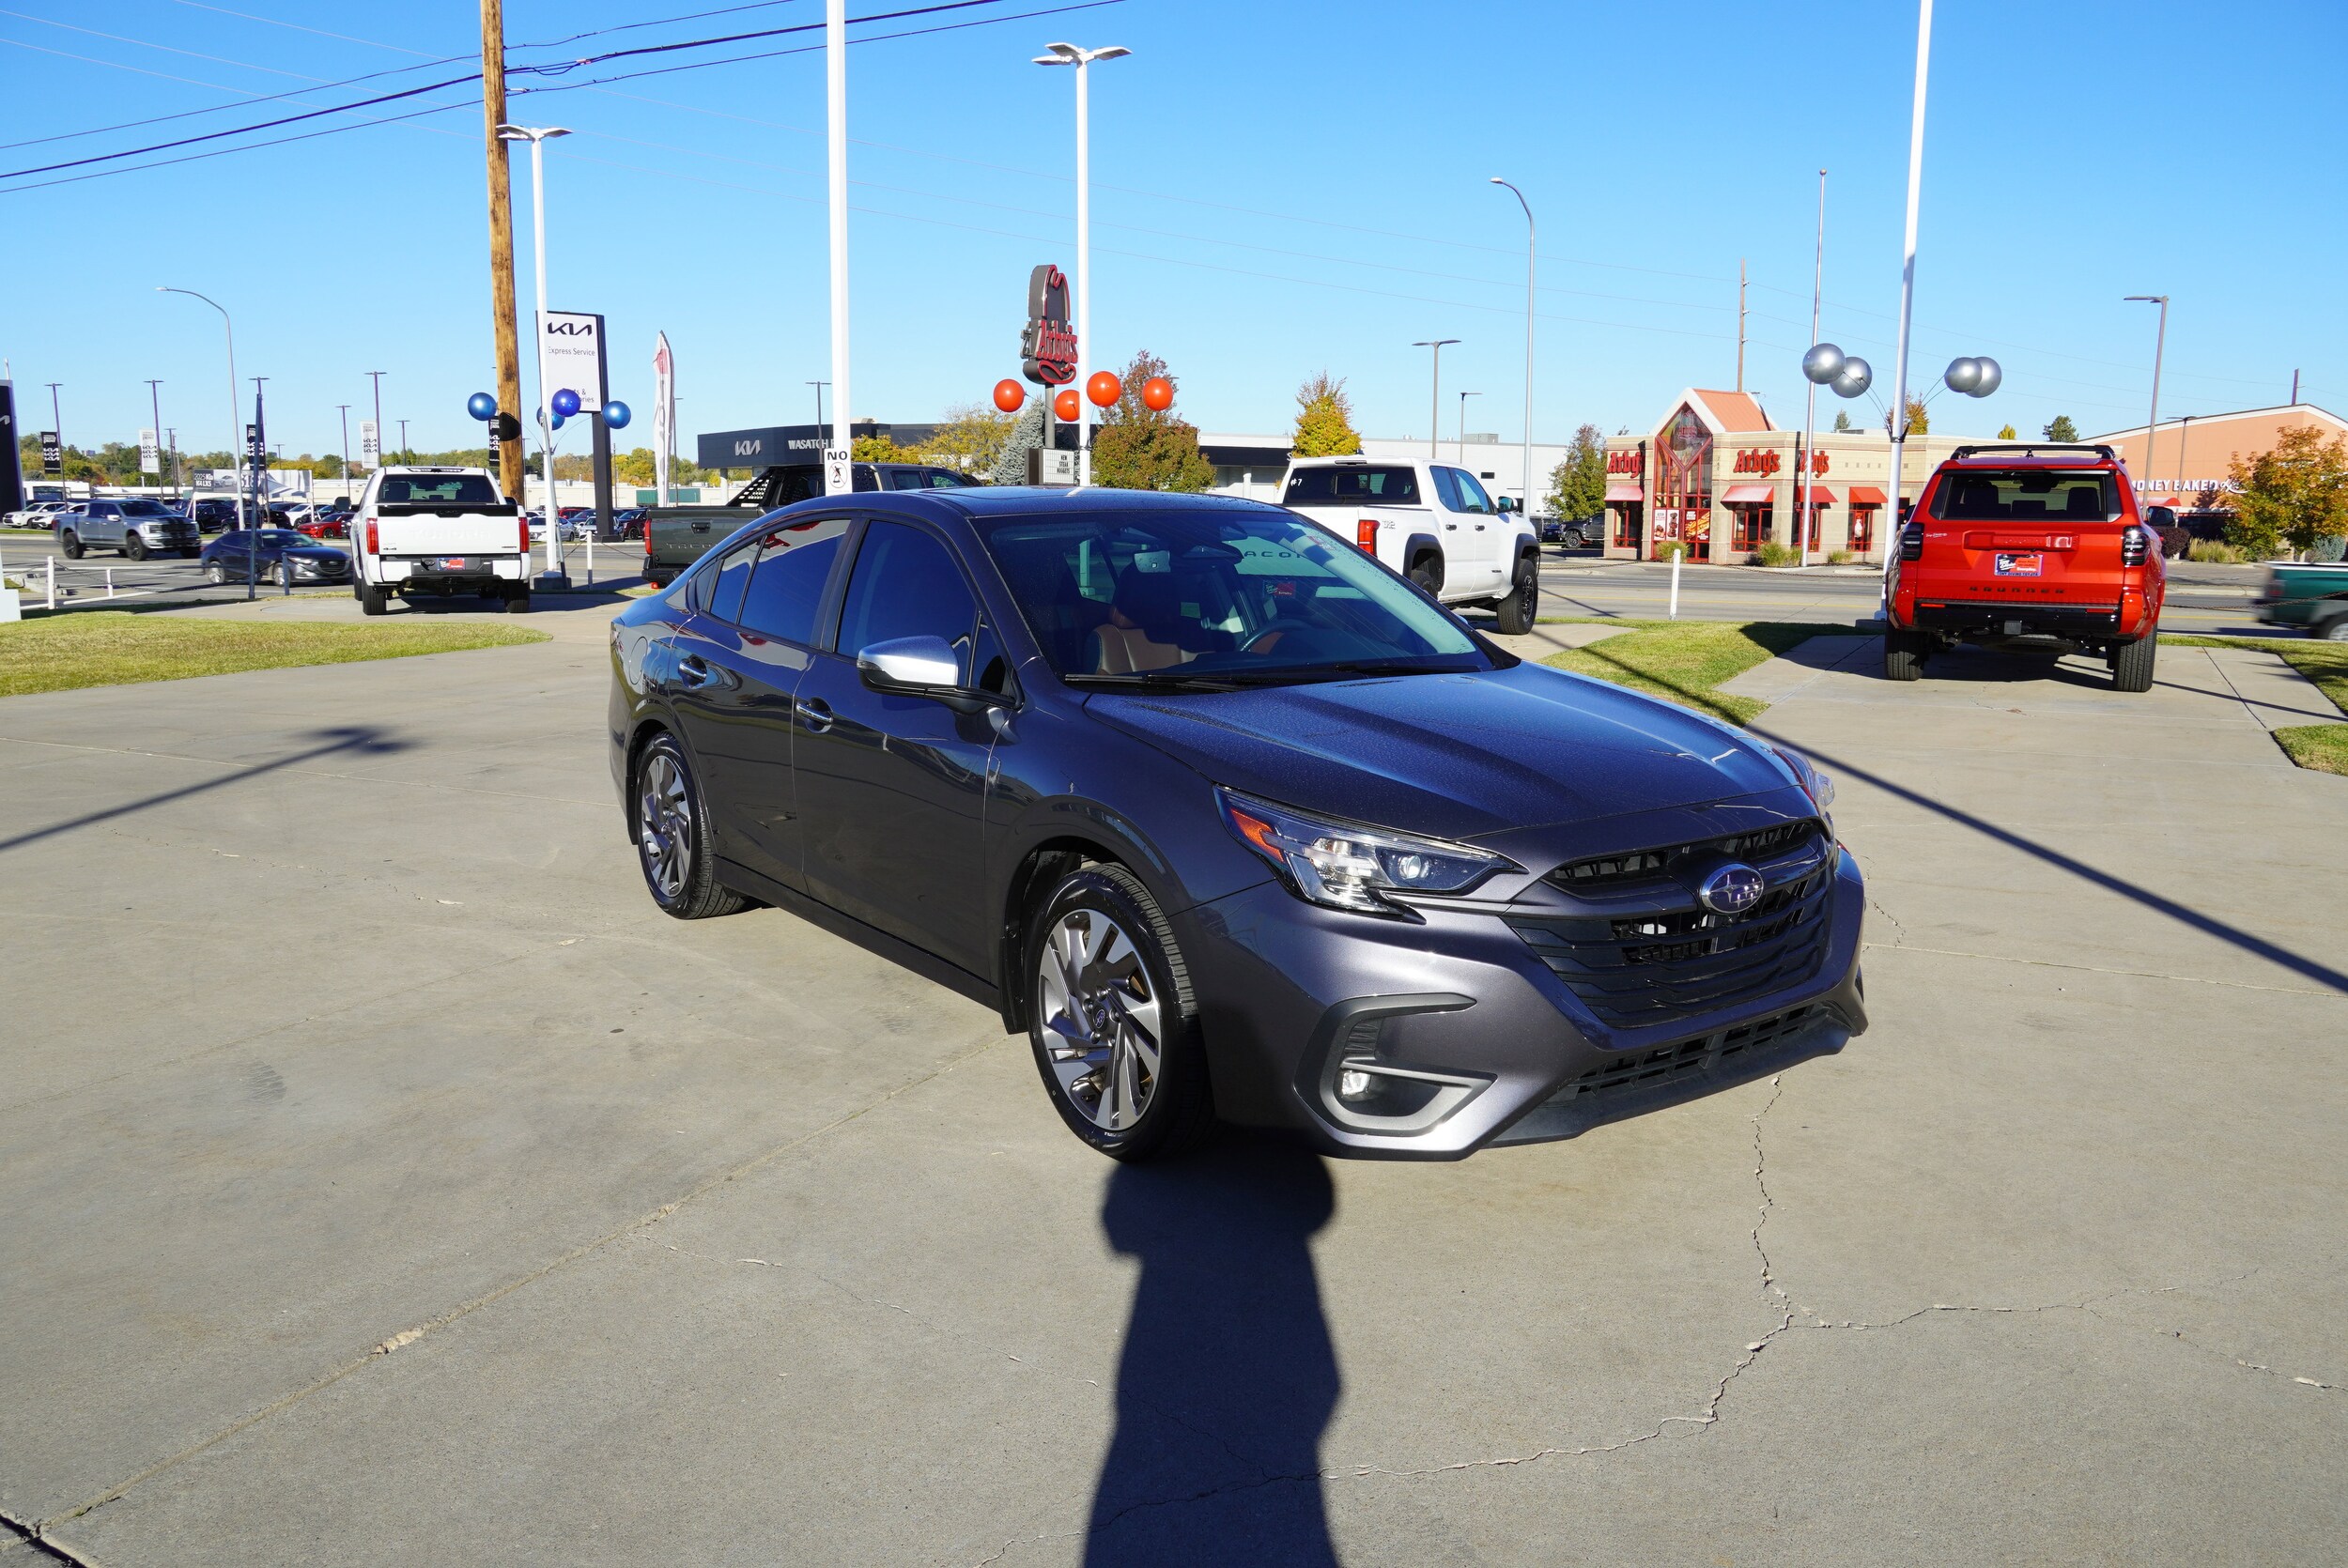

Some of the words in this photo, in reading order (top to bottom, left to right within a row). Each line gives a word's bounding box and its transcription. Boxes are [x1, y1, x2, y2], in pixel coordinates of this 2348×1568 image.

[548, 322, 593, 336] KIA
[1035, 319, 1078, 364] Arby's
[548, 346, 572, 356] Express
[573, 347, 595, 357] Service
[735, 439, 760, 456] KIA
[788, 438, 829, 450] WASATCH
[827, 451, 847, 460] NO
[1607, 452, 1644, 478] Arby's
[1733, 449, 1781, 478] Arby's
[1798, 449, 1830, 479] Aby's
[2173, 480, 2218, 491] BAKED
